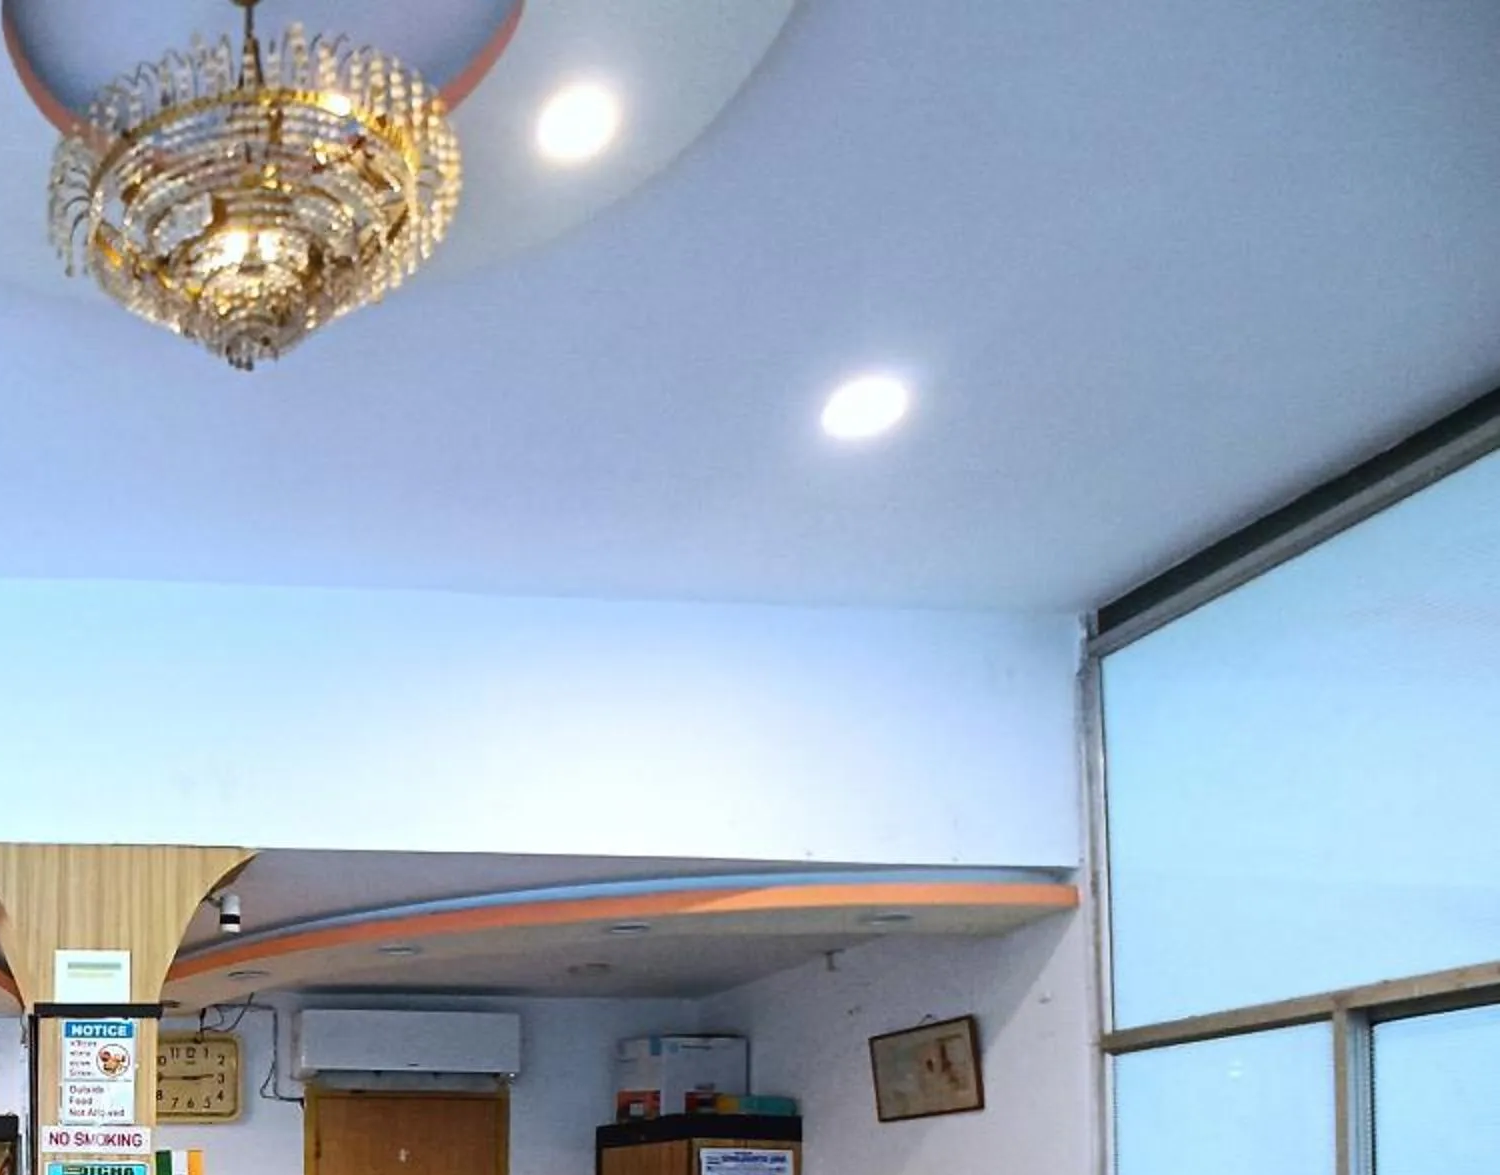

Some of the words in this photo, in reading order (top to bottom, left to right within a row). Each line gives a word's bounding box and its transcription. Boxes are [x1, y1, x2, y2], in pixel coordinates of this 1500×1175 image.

[71, 1024, 128, 1037] NOTICE
[170, 1046, 179, 1060] 11
[69, 1096, 93, 1105] Food
[49, 1131, 70, 1146] NO
[74, 1131, 143, 1148] SMOKING
